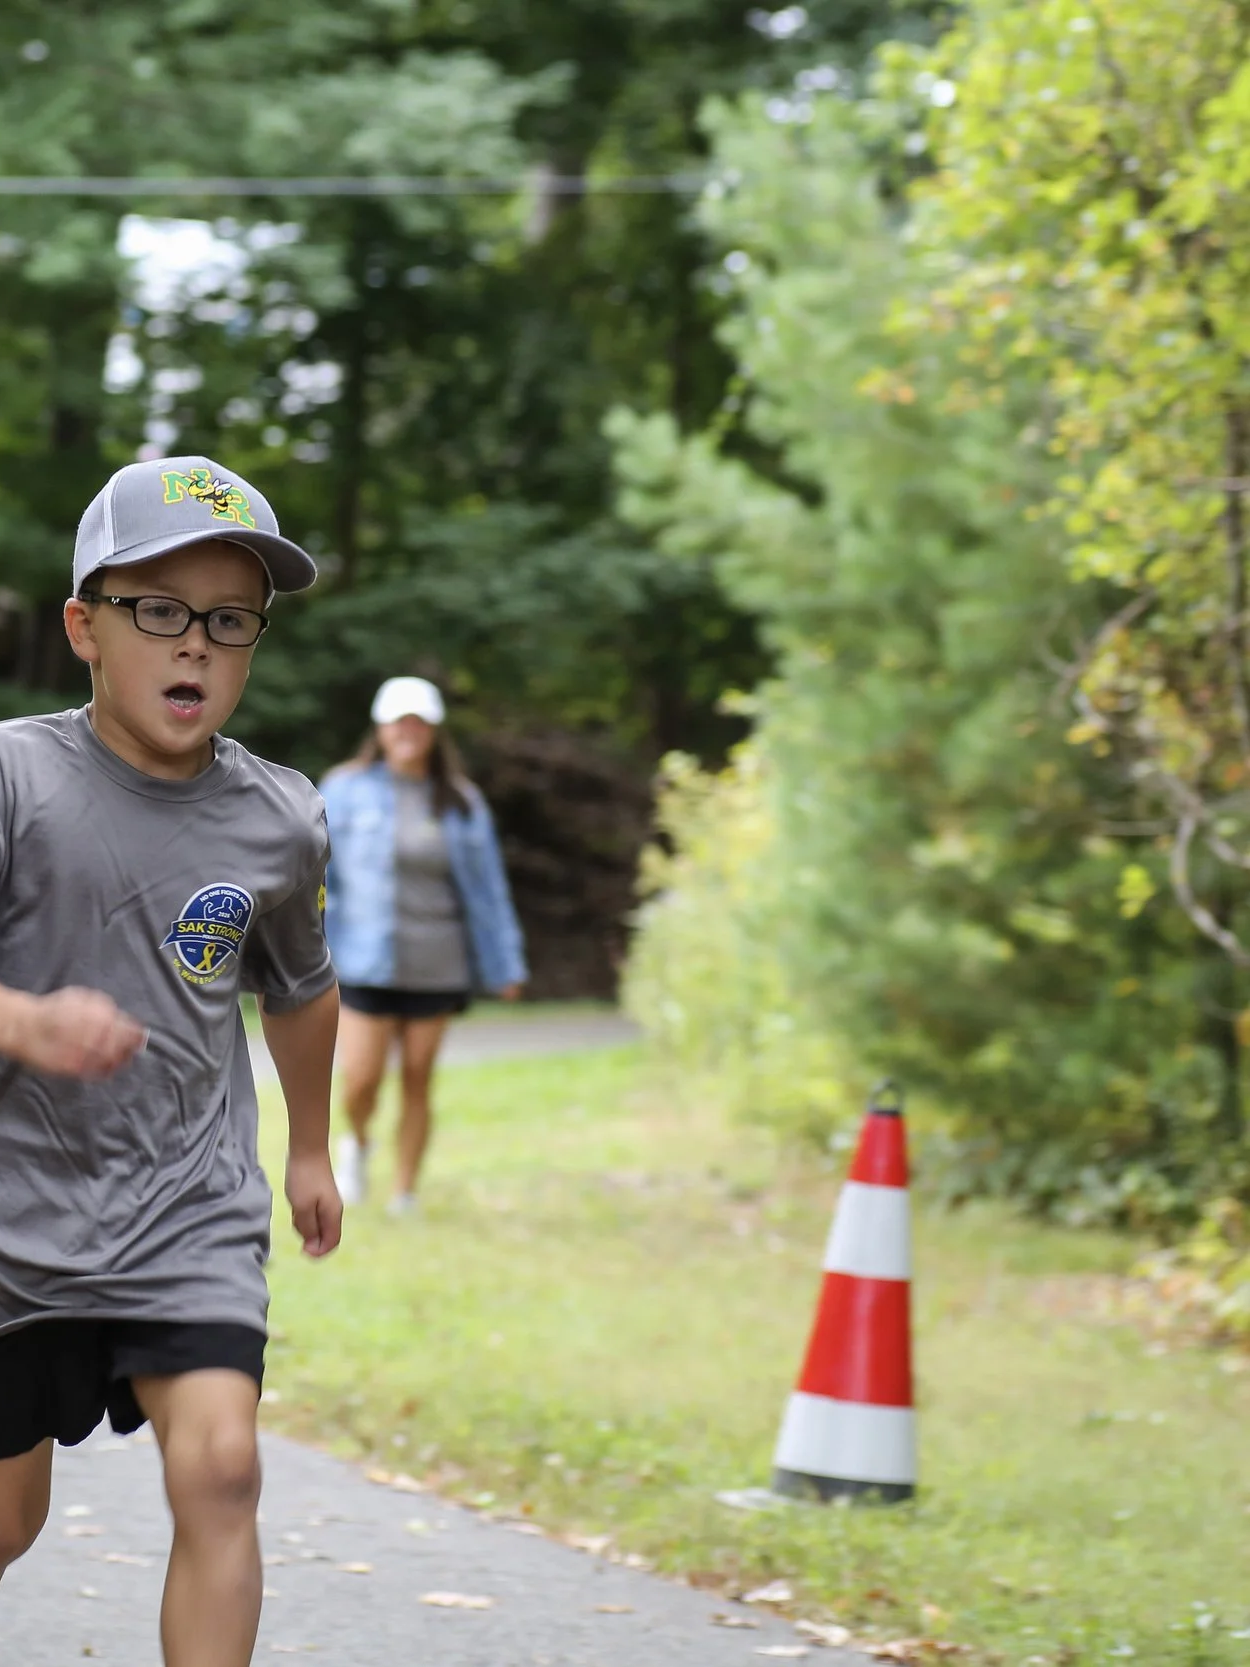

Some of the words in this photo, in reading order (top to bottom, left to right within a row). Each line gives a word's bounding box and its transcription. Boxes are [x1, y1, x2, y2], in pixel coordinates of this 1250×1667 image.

[199, 894, 209, 903] NO
[177, 921, 206, 933] SAK
[206, 924, 243, 942] STRONG
